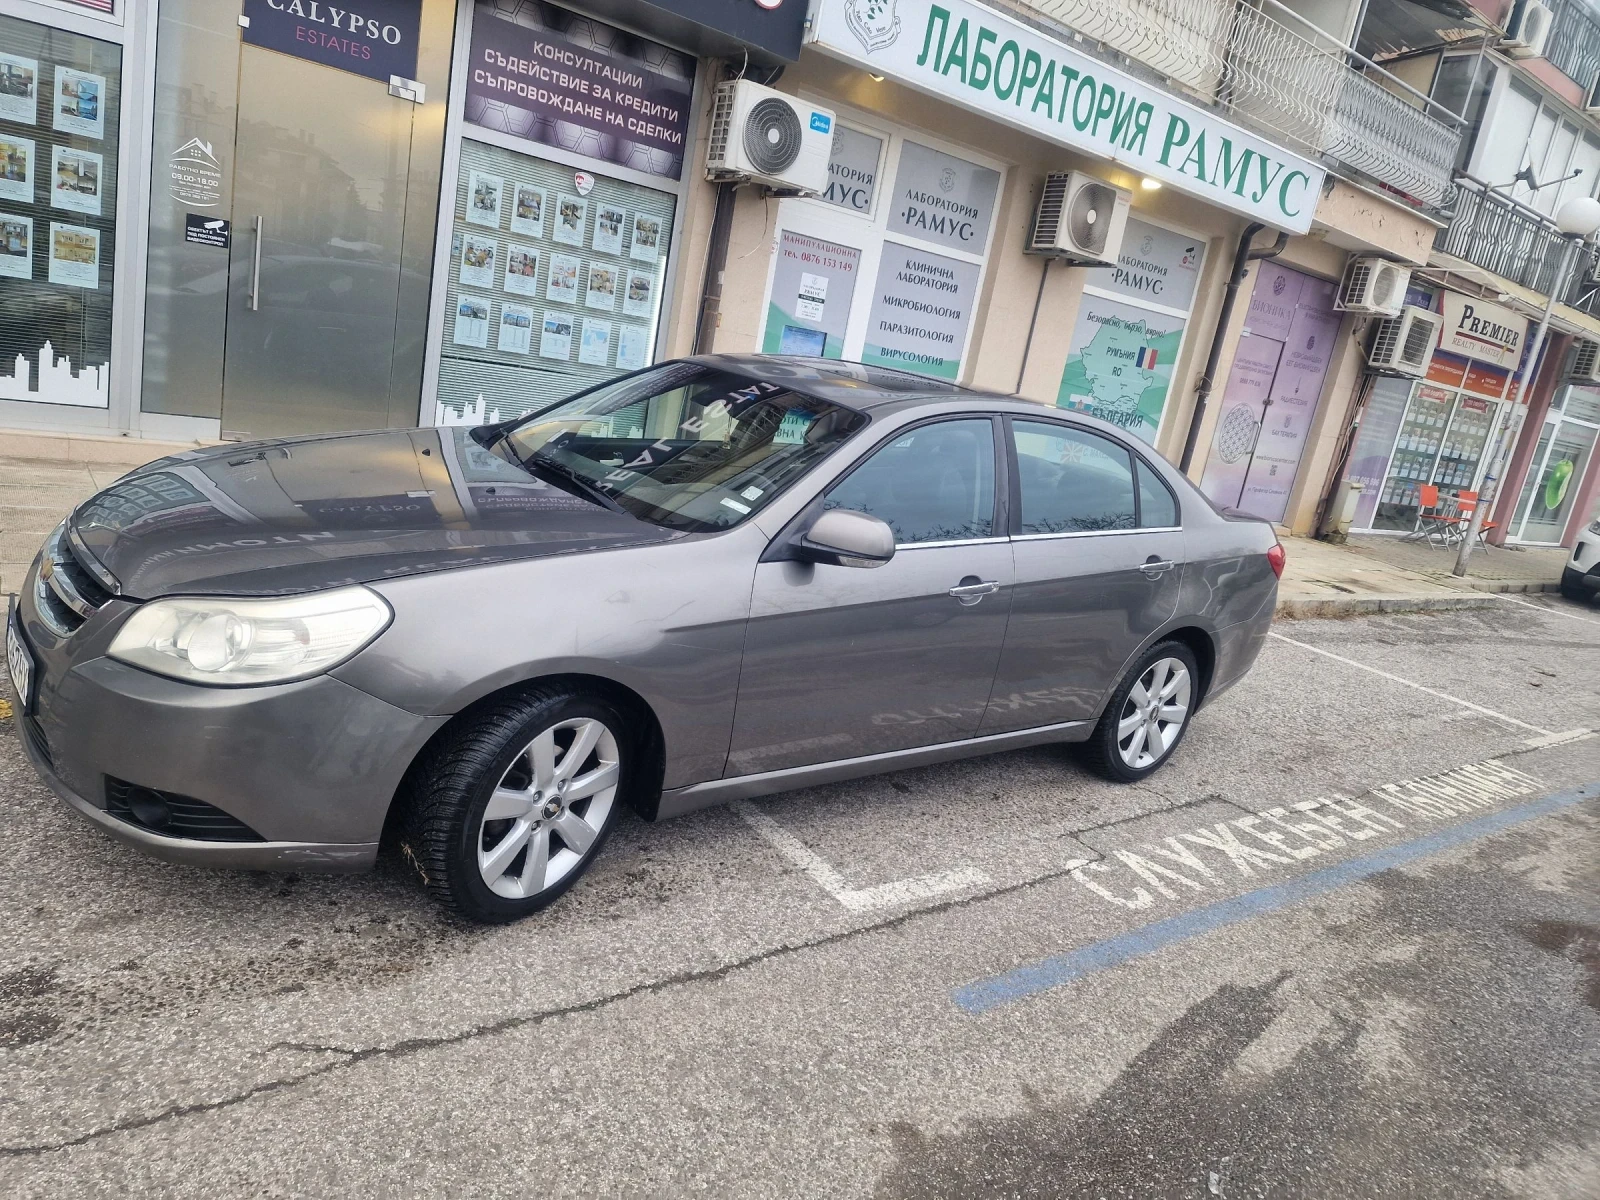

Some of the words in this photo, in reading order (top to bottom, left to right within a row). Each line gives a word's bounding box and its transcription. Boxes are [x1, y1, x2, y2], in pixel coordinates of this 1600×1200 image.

[266, 0, 402, 45] CALYPSO
[296, 25, 372, 60] ESTATES
[533, 40, 643, 89] КОНСУЛТАЦИИ
[484, 48, 589, 95] СЪДЕЙСТВИЕ
[592, 83, 612, 102] ЗА
[615, 92, 679, 123] КРЕДИТИ
[474, 69, 603, 121] СЪПРОВОЖДАНЕ
[605, 109, 625, 127] НА
[627, 117, 682, 145] СДЕЛКИ
[916, 4, 1154, 156] ЛАБОРАТОРИЯ
[1157, 112, 1312, 217] РАМУС
[905, 188, 979, 220] ЛАБОРАТОРИЯ
[783, 234, 857, 259] МАНИПУЛАЦИОННА
[783, 248, 798, 260] тел.
[801, 251, 821, 265] 0876
[823, 257, 837, 269] 153
[839, 260, 853, 272] 149
[905, 259, 954, 280] КЛИНИЧНА
[896, 271, 959, 294] ЛАБОРАТОРИЯ
[882, 294, 961, 320] МИКРОБИОЛОГИЯ
[879, 320, 954, 344] ПАРАЗИТОЛОГИЯ
[1086, 311, 1121, 329] Безопасно,
[1106, 346, 1136, 361] РУМЪНИЯ
[1452, 337, 1476, 351] REALTY
[880, 347, 944, 367] ВИРУСОЛОГИЯ
[1112, 366, 1122, 377] RO
[1065, 794, 1406, 911] СЛУЖЕБЕН
